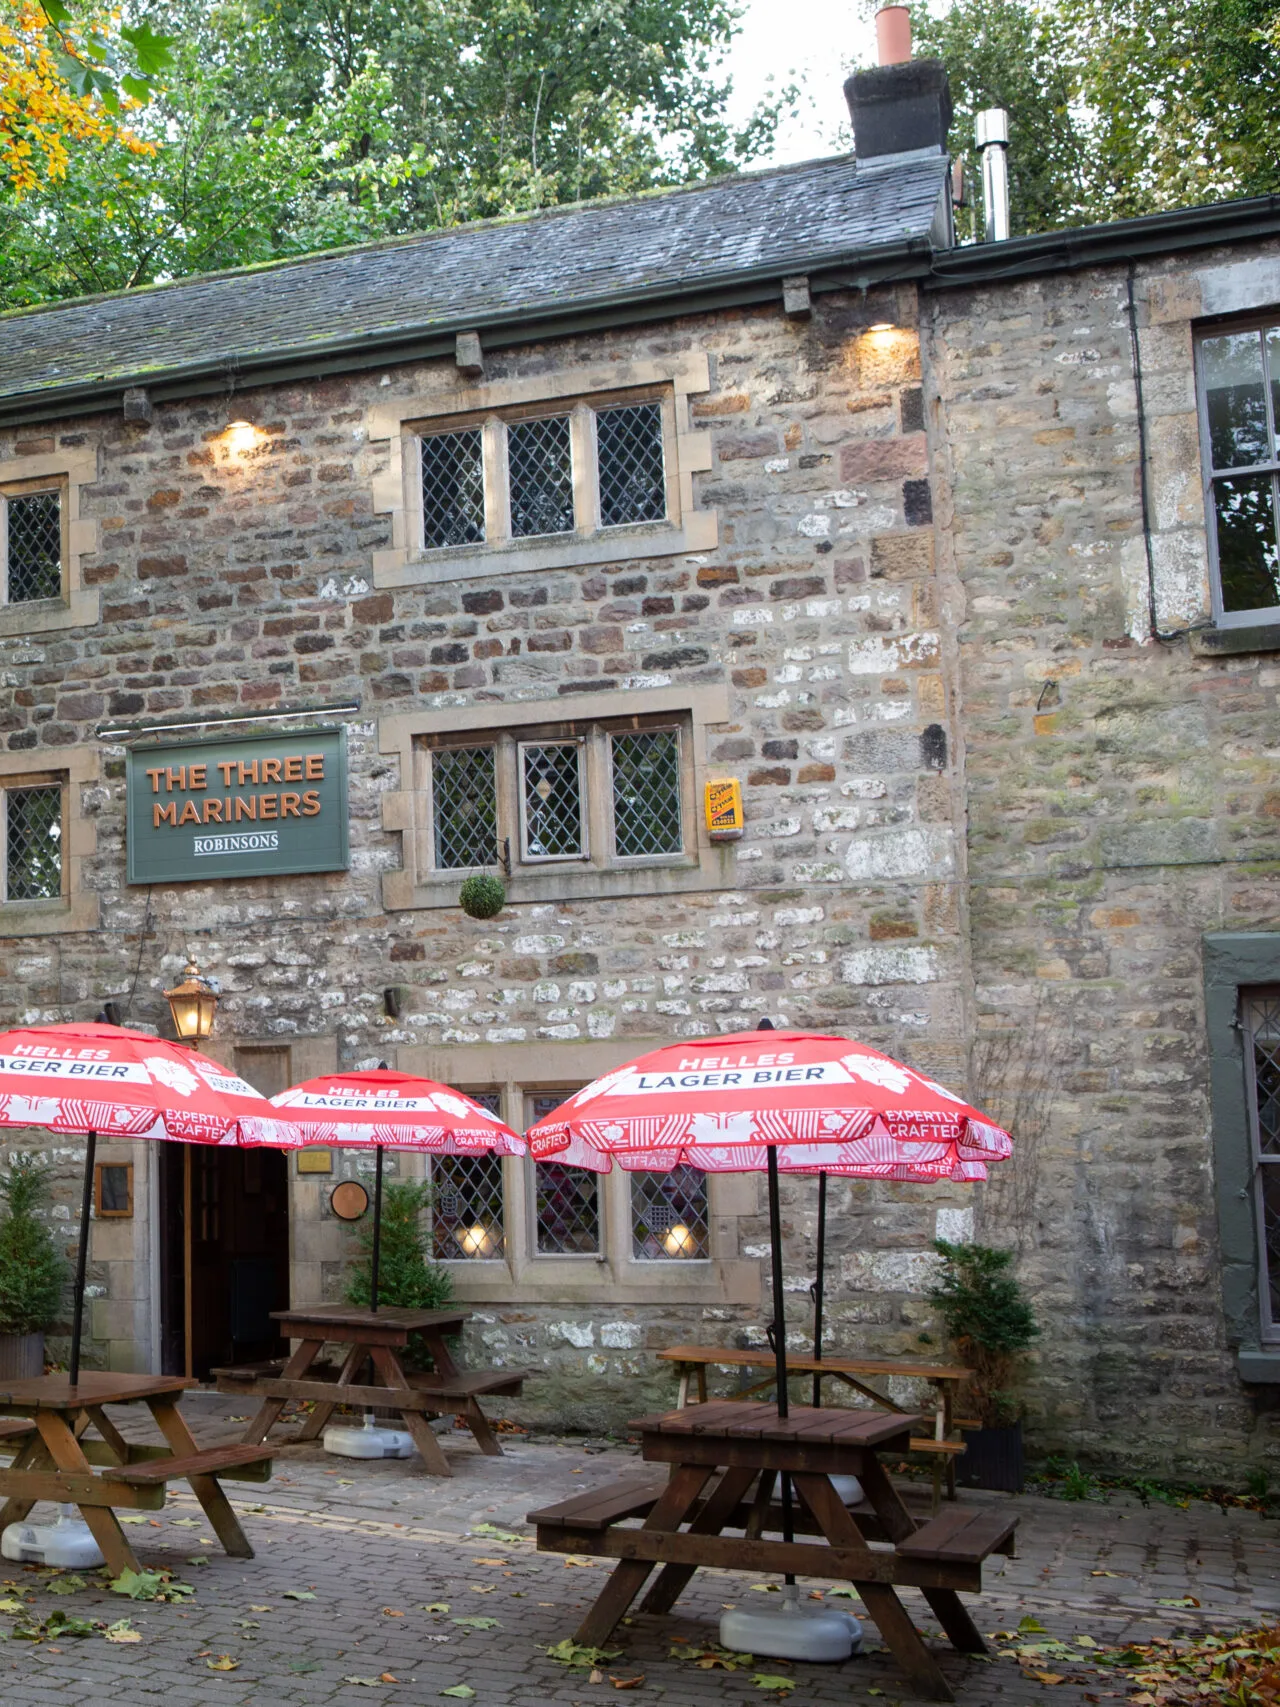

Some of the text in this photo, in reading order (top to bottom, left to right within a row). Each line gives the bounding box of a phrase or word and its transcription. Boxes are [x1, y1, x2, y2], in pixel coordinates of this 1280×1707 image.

[146, 754, 325, 793] THE THREE
[153, 790, 321, 827] MARINERS
[194, 834, 279, 853] ROBINSONS
[12, 1044, 111, 1060] HELLES
[678, 1052, 795, 1070] HELLES
[69, 1063, 129, 1077] BIER
[638, 1067, 825, 1089] LAGER BIER
[328, 1086, 400, 1098] HELLES
[304, 1096, 418, 1109] LAGER BIER
[166, 1109, 230, 1129] EXPERTLY
[885, 1110, 960, 1122] EXPERTLY
[453, 1128, 497, 1138] EXPERTLY
[889, 1124, 961, 1138] CRAFTED
[455, 1137, 497, 1146] CRAFTED
[531, 1133, 569, 1153] CRAFTED
